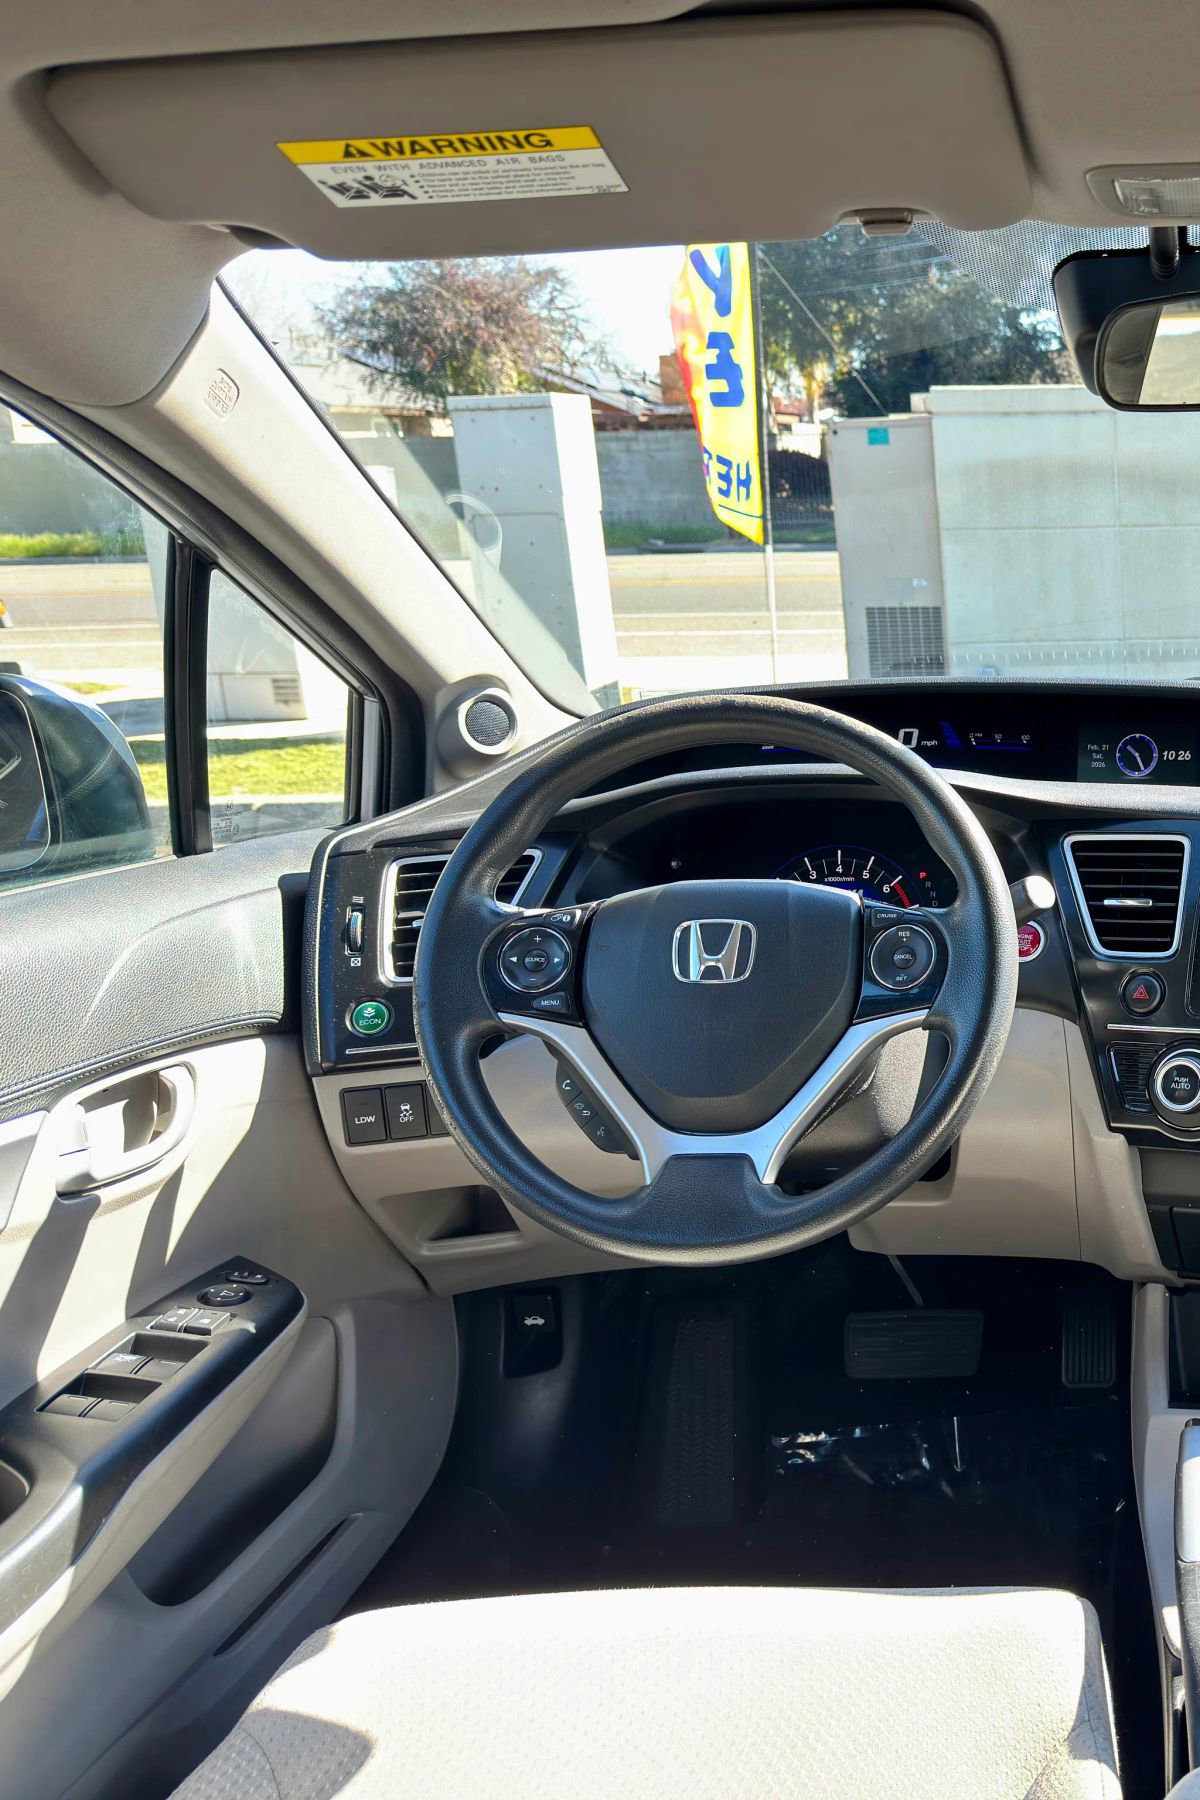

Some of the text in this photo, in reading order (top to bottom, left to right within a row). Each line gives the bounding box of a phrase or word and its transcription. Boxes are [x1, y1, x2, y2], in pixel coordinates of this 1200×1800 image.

[370, 132, 555, 158] WARNING
[331, 165, 367, 174] EVEN
[373, 163, 411, 172] WITH
[418, 159, 488, 170] ADVANCED
[496, 156, 521, 166] AIR
[528, 154, 566, 164] BAGS
[921, 739, 938, 747] mph
[836, 865, 843, 873] 4
[809, 871, 817, 879] 3
[862, 871, 870, 879] 5
[883, 884, 891, 893] 6
[541, 999, 560, 1007] MENU
[359, 1017, 382, 1026] ECON
[1171, 1082, 1191, 1090] AUTO
[355, 1115, 376, 1124] LDW
[400, 1115, 414, 1123] OFF
